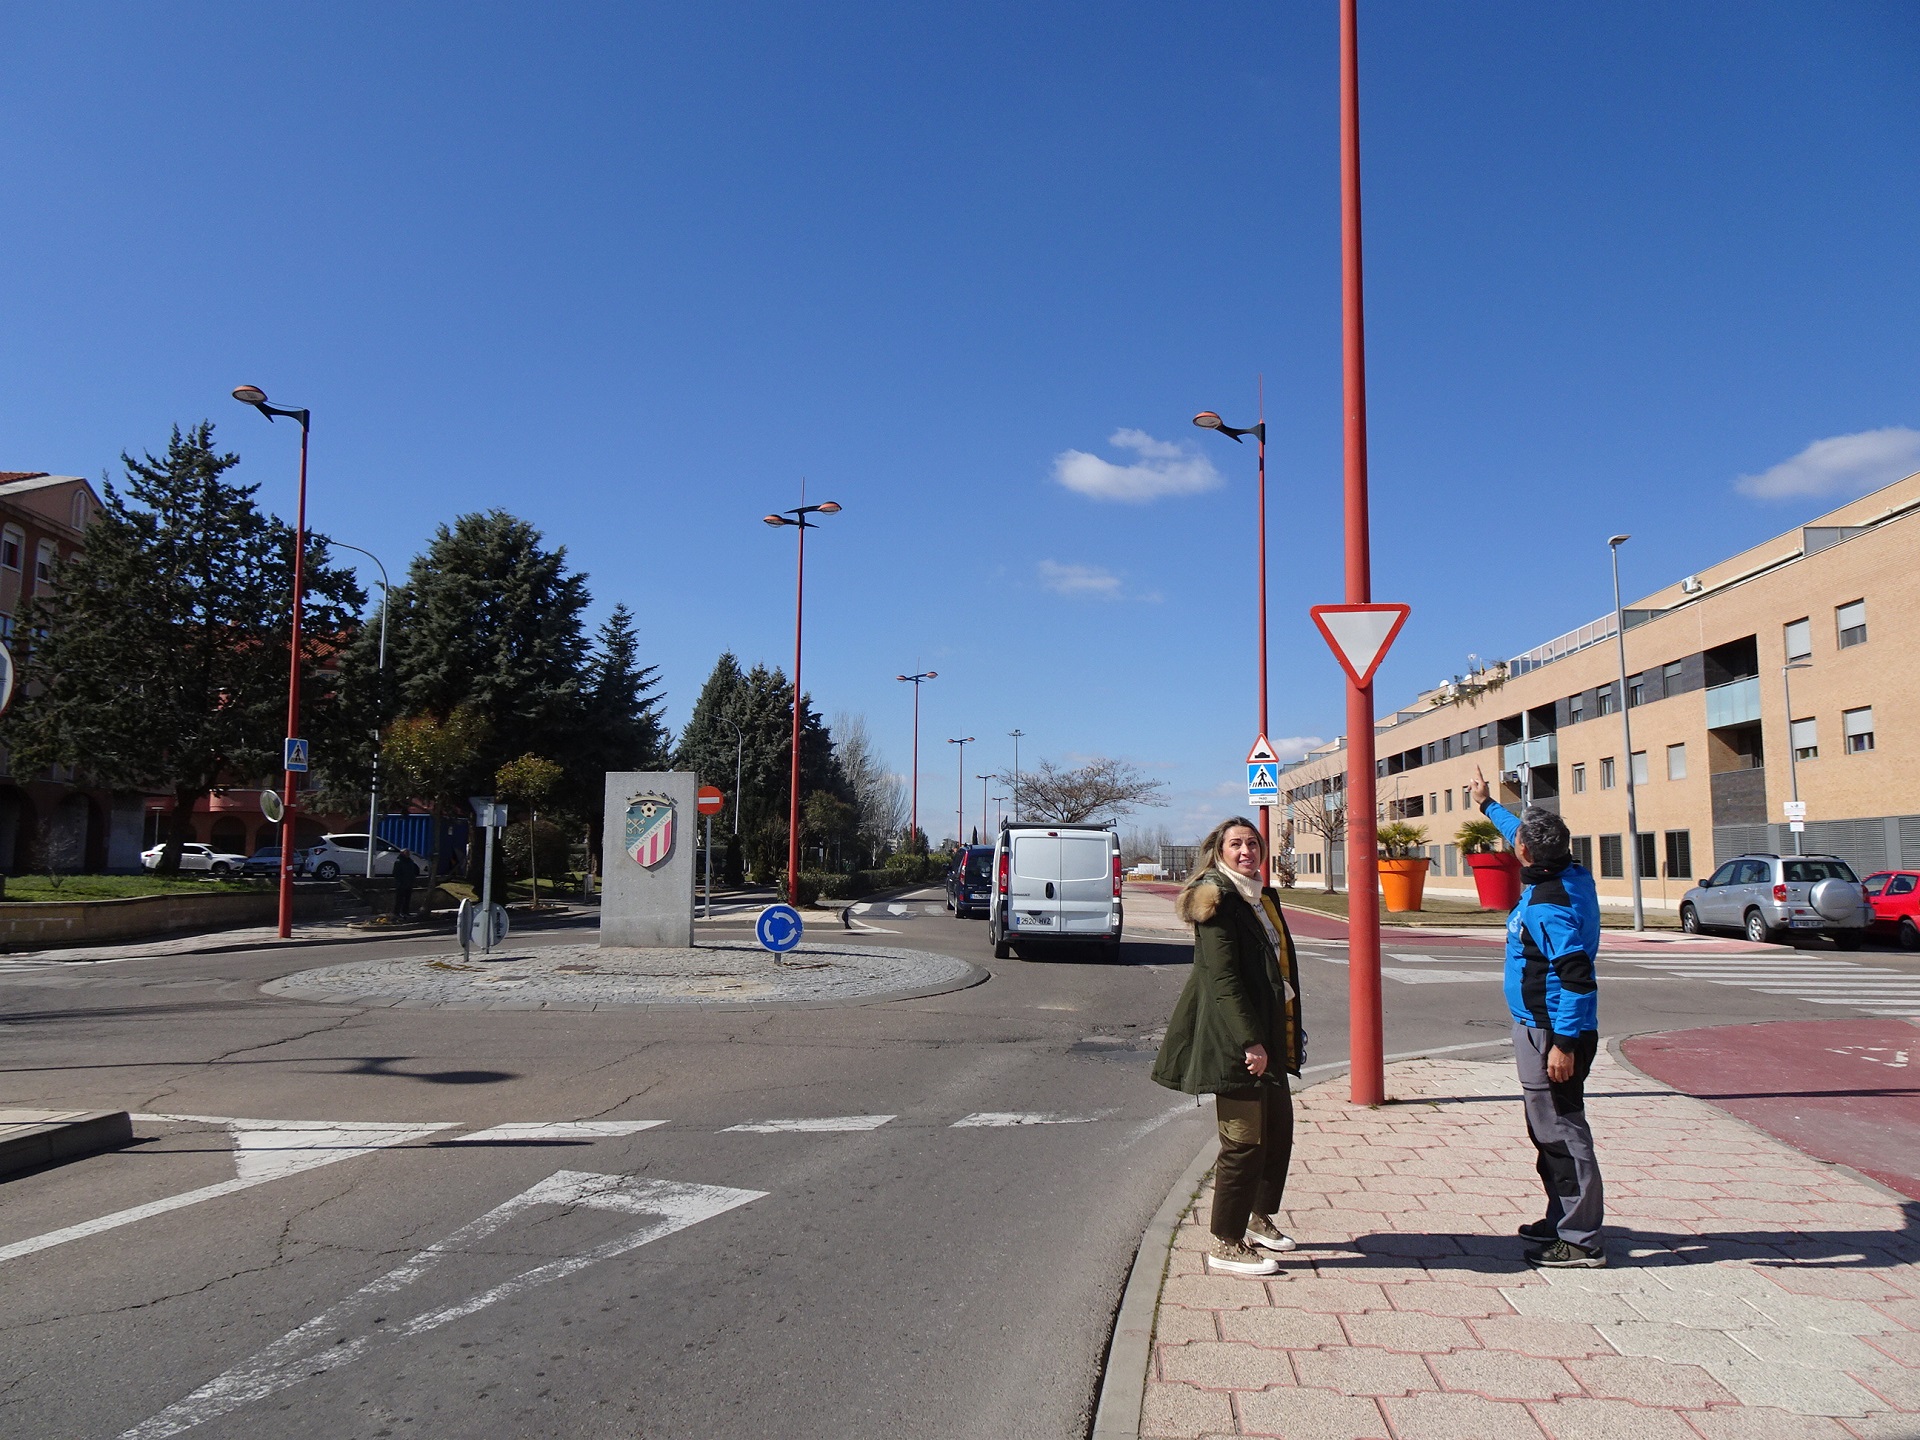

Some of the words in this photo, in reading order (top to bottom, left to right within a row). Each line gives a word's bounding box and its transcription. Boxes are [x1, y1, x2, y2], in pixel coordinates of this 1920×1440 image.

[639, 830, 655, 844] SANTA
[654, 815, 671, 831] MARTA
[1021, 917, 1037, 925] 2520
